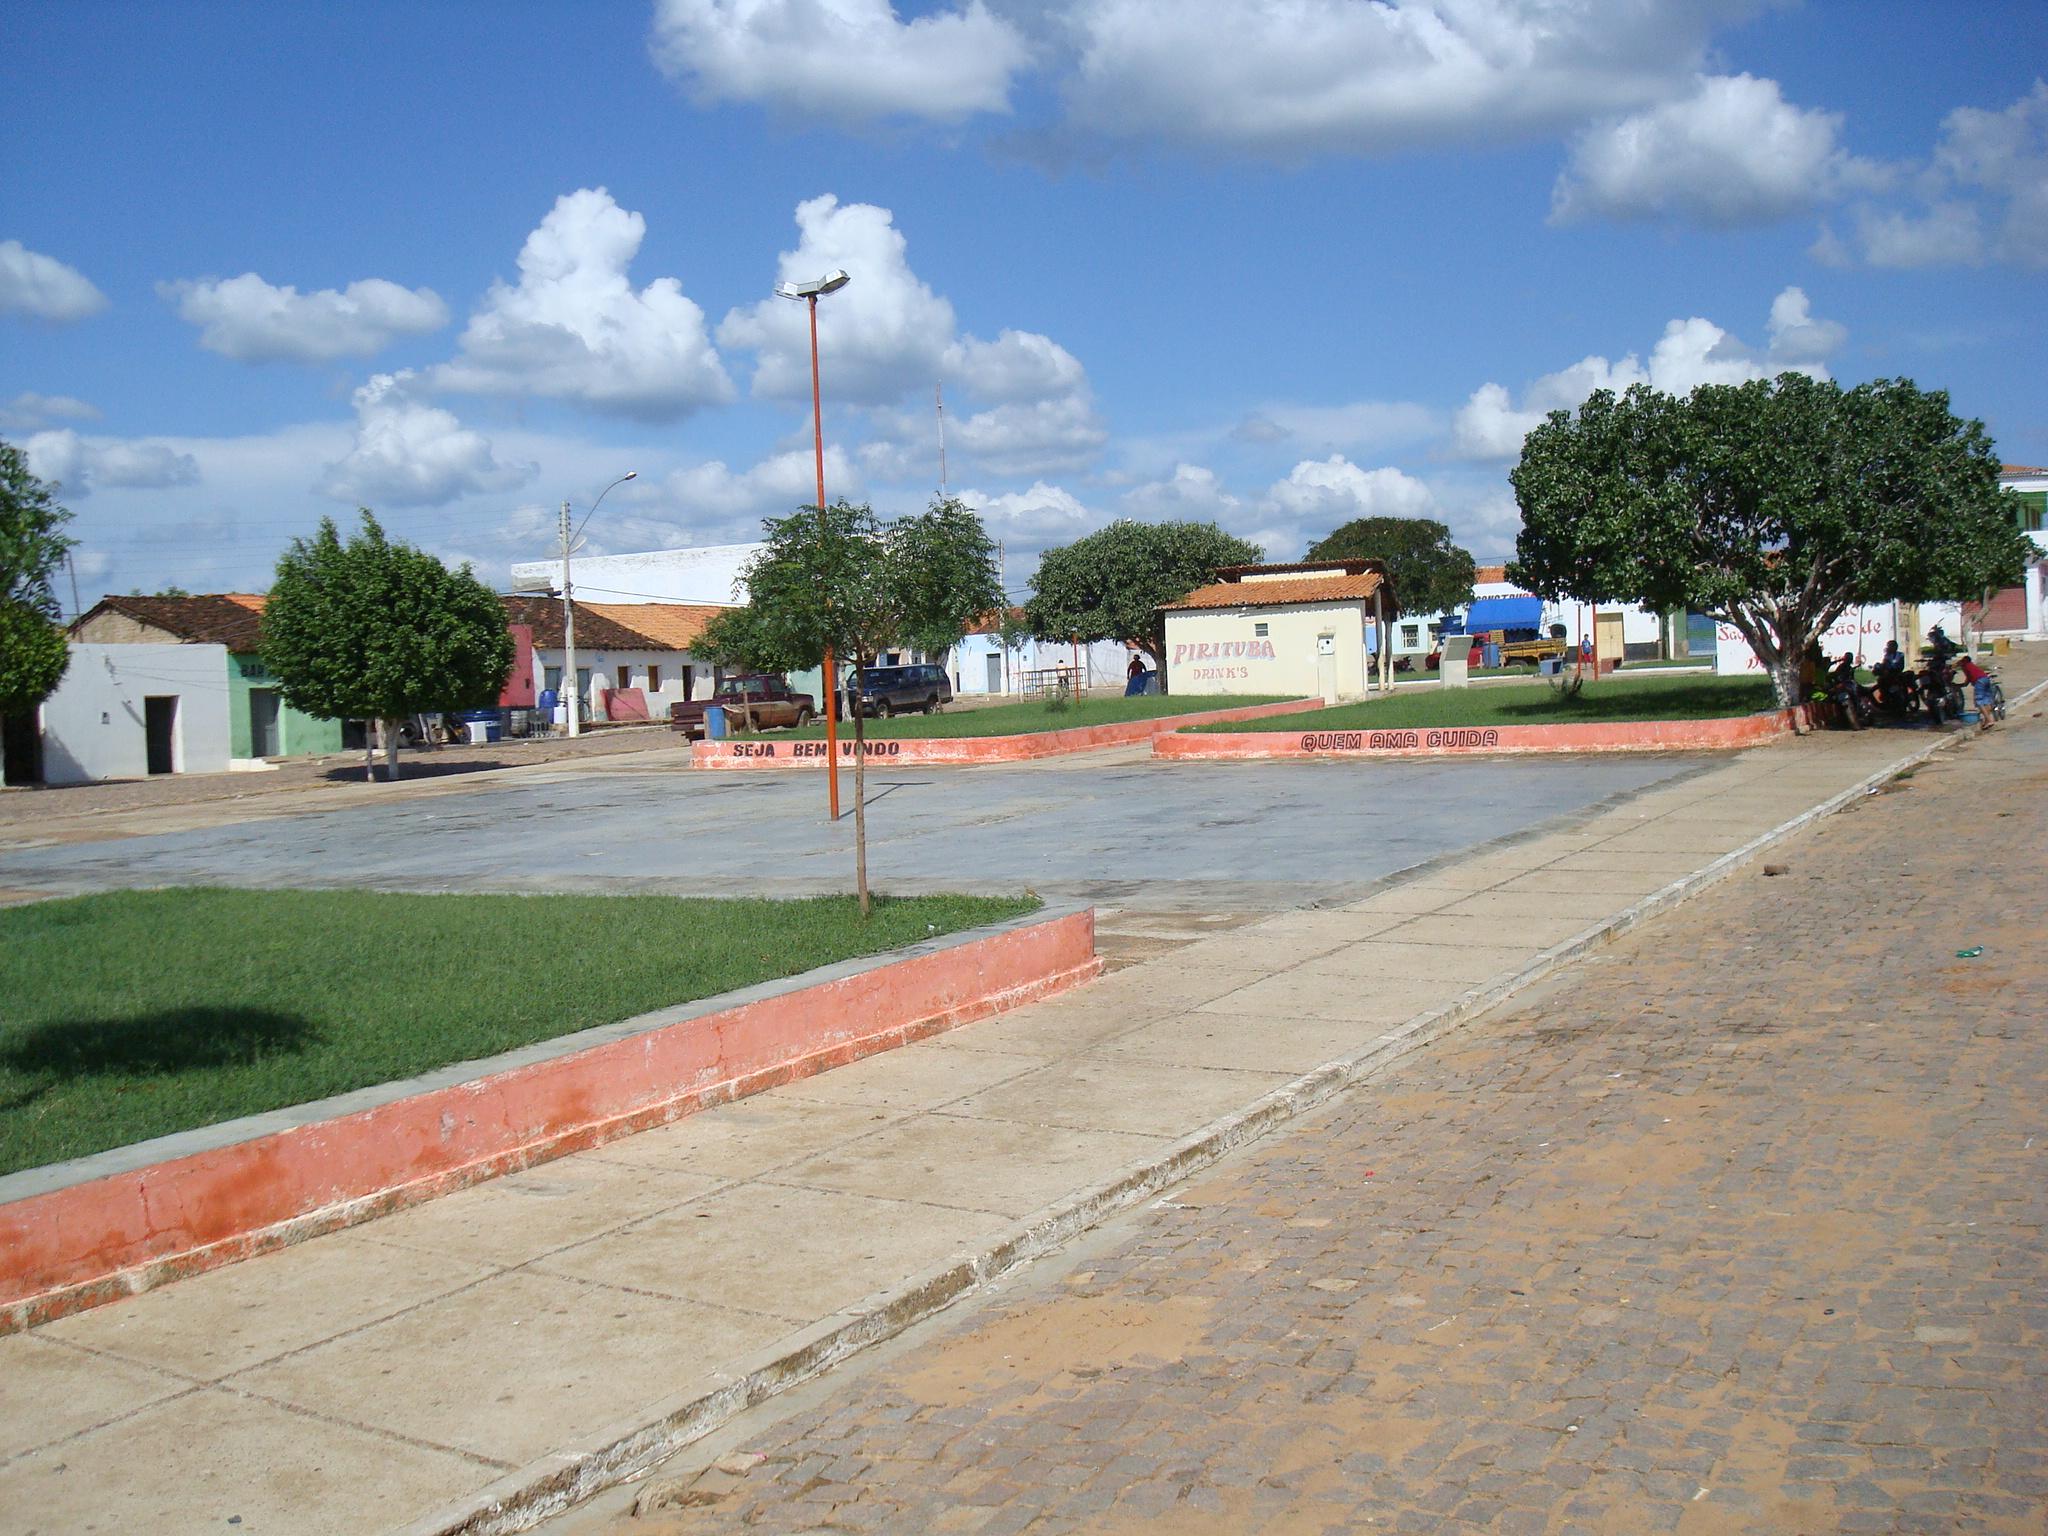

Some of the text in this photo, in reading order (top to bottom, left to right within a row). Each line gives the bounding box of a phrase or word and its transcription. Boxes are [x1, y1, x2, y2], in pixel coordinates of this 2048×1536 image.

[1173, 640, 1276, 665] PIRITUBA
[1193, 666, 1249, 681] DRINK'S
[733, 743, 775, 757] SEJA
[793, 742, 827, 757] BEM
[1301, 729, 1499, 752] QUEM AMA CUIDA
